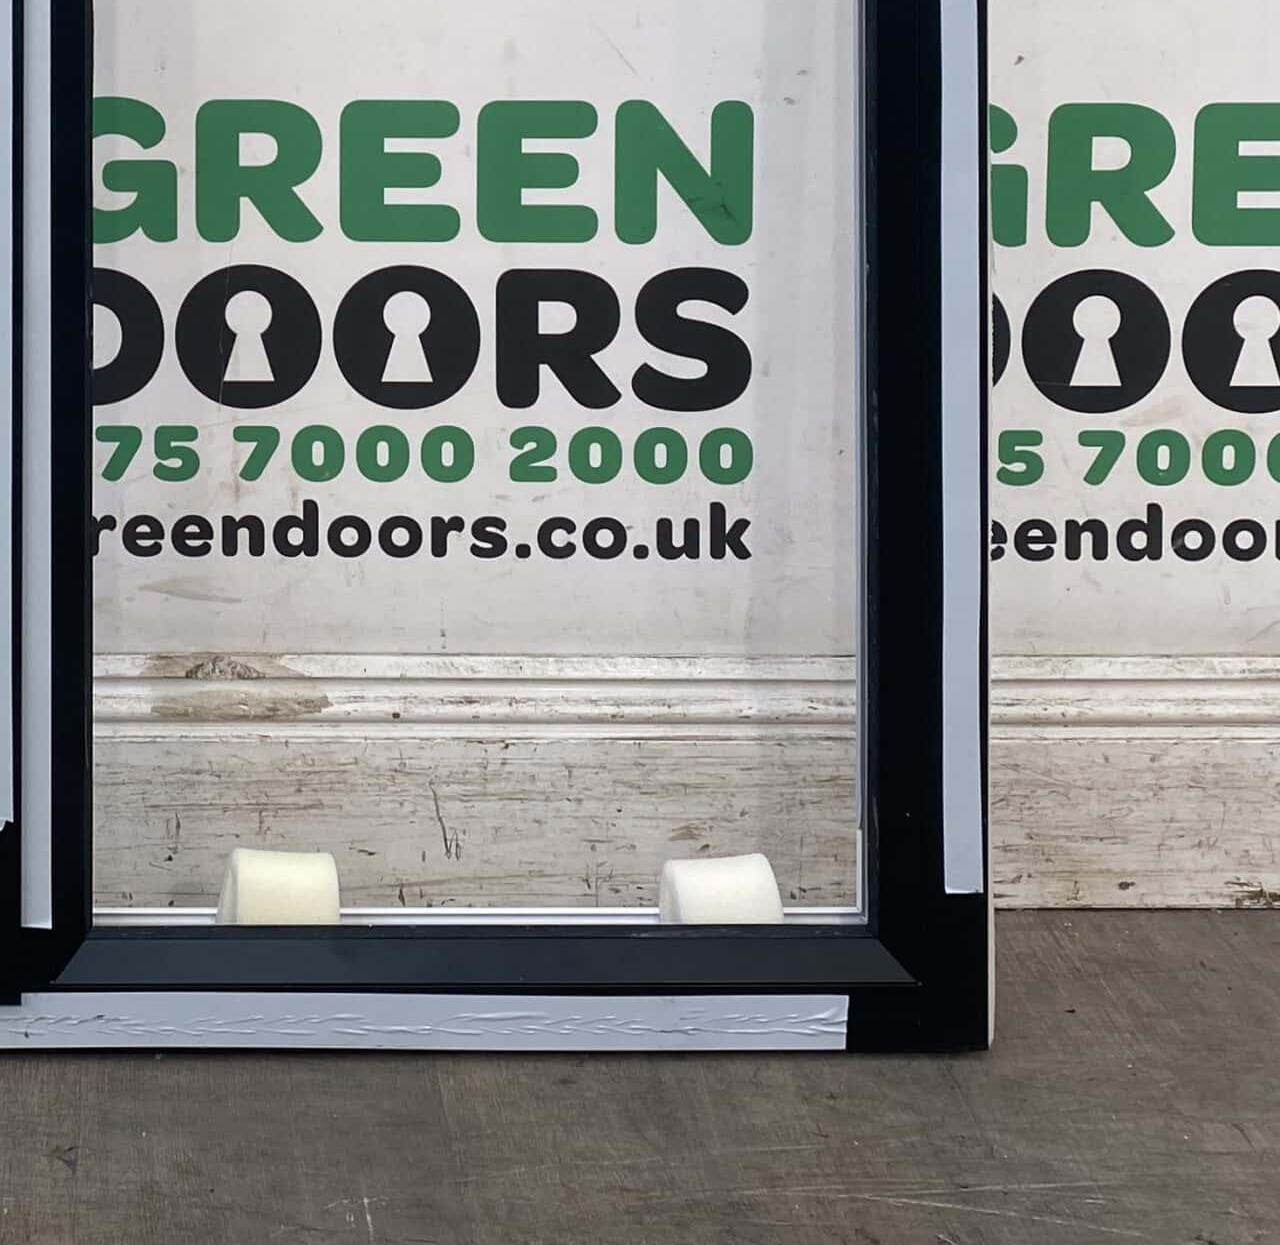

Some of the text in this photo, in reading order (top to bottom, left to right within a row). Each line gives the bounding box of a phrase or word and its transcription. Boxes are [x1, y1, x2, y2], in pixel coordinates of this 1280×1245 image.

[232, 424, 476, 484] 7000
[508, 426, 754, 486] 2000
[1077, 428, 1280, 487] 700
